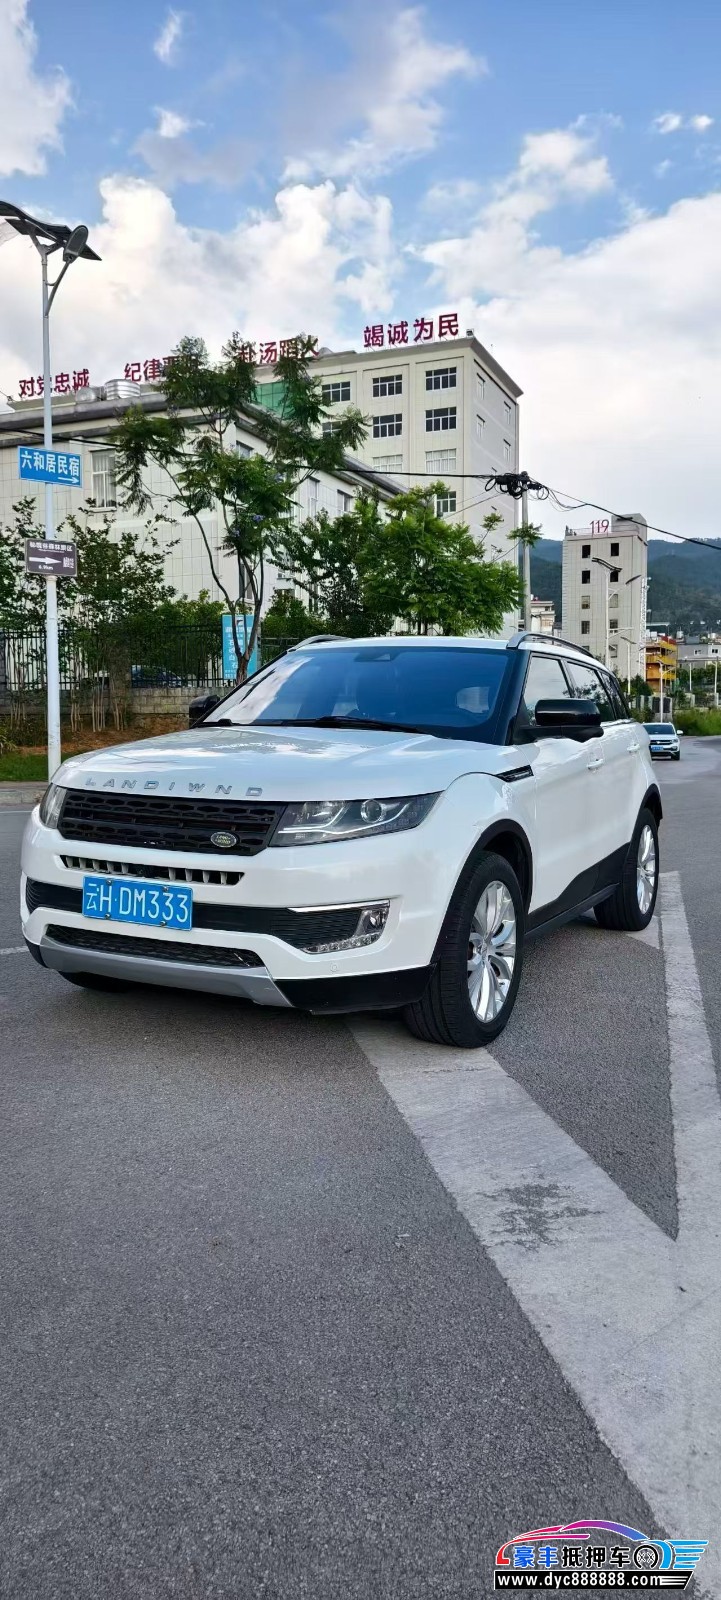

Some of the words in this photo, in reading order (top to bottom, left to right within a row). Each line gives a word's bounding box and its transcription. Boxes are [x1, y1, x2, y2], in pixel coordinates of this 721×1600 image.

[363, 313, 459, 348] 竭诚为民
[21, 450, 80, 477] 六和居民宿
[590, 519, 610, 534] 119
[85, 777, 263, 797] LANDIWND
